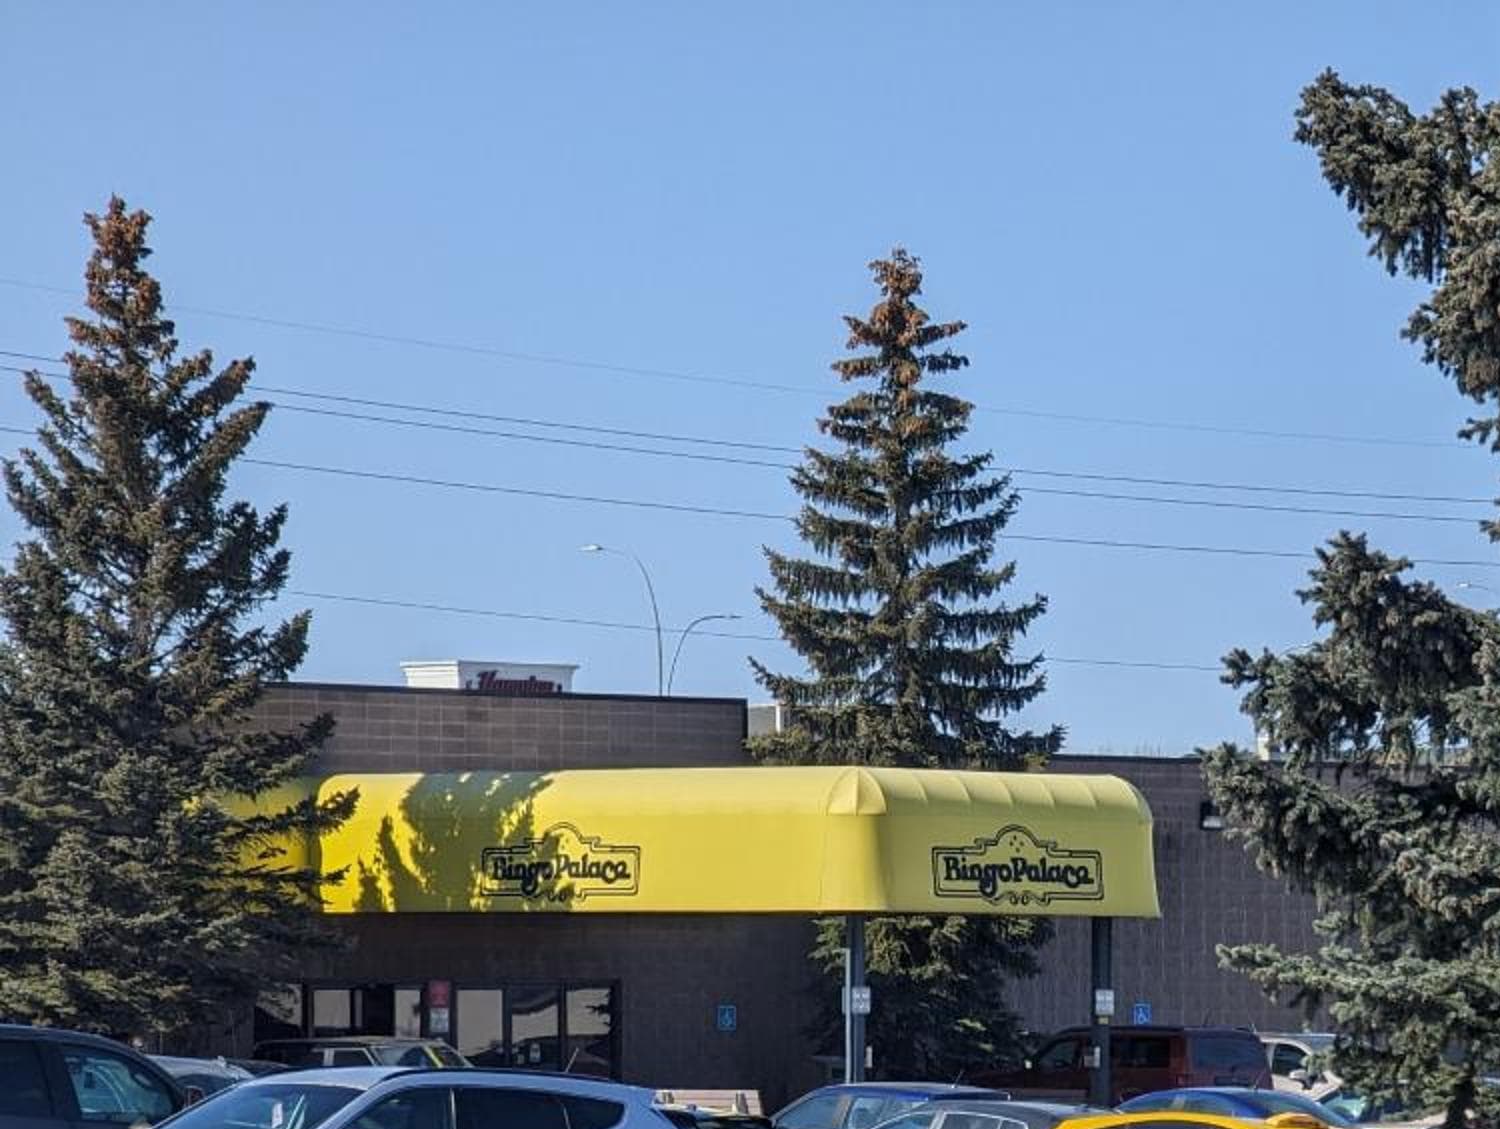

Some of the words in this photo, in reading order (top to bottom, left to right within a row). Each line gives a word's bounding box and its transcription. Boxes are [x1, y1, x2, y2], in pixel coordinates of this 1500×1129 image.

[492, 855, 553, 895] Bingo
[553, 853, 631, 884] Palace
[942, 855, 1010, 898] Bingo
[1010, 857, 1094, 888] Palace
